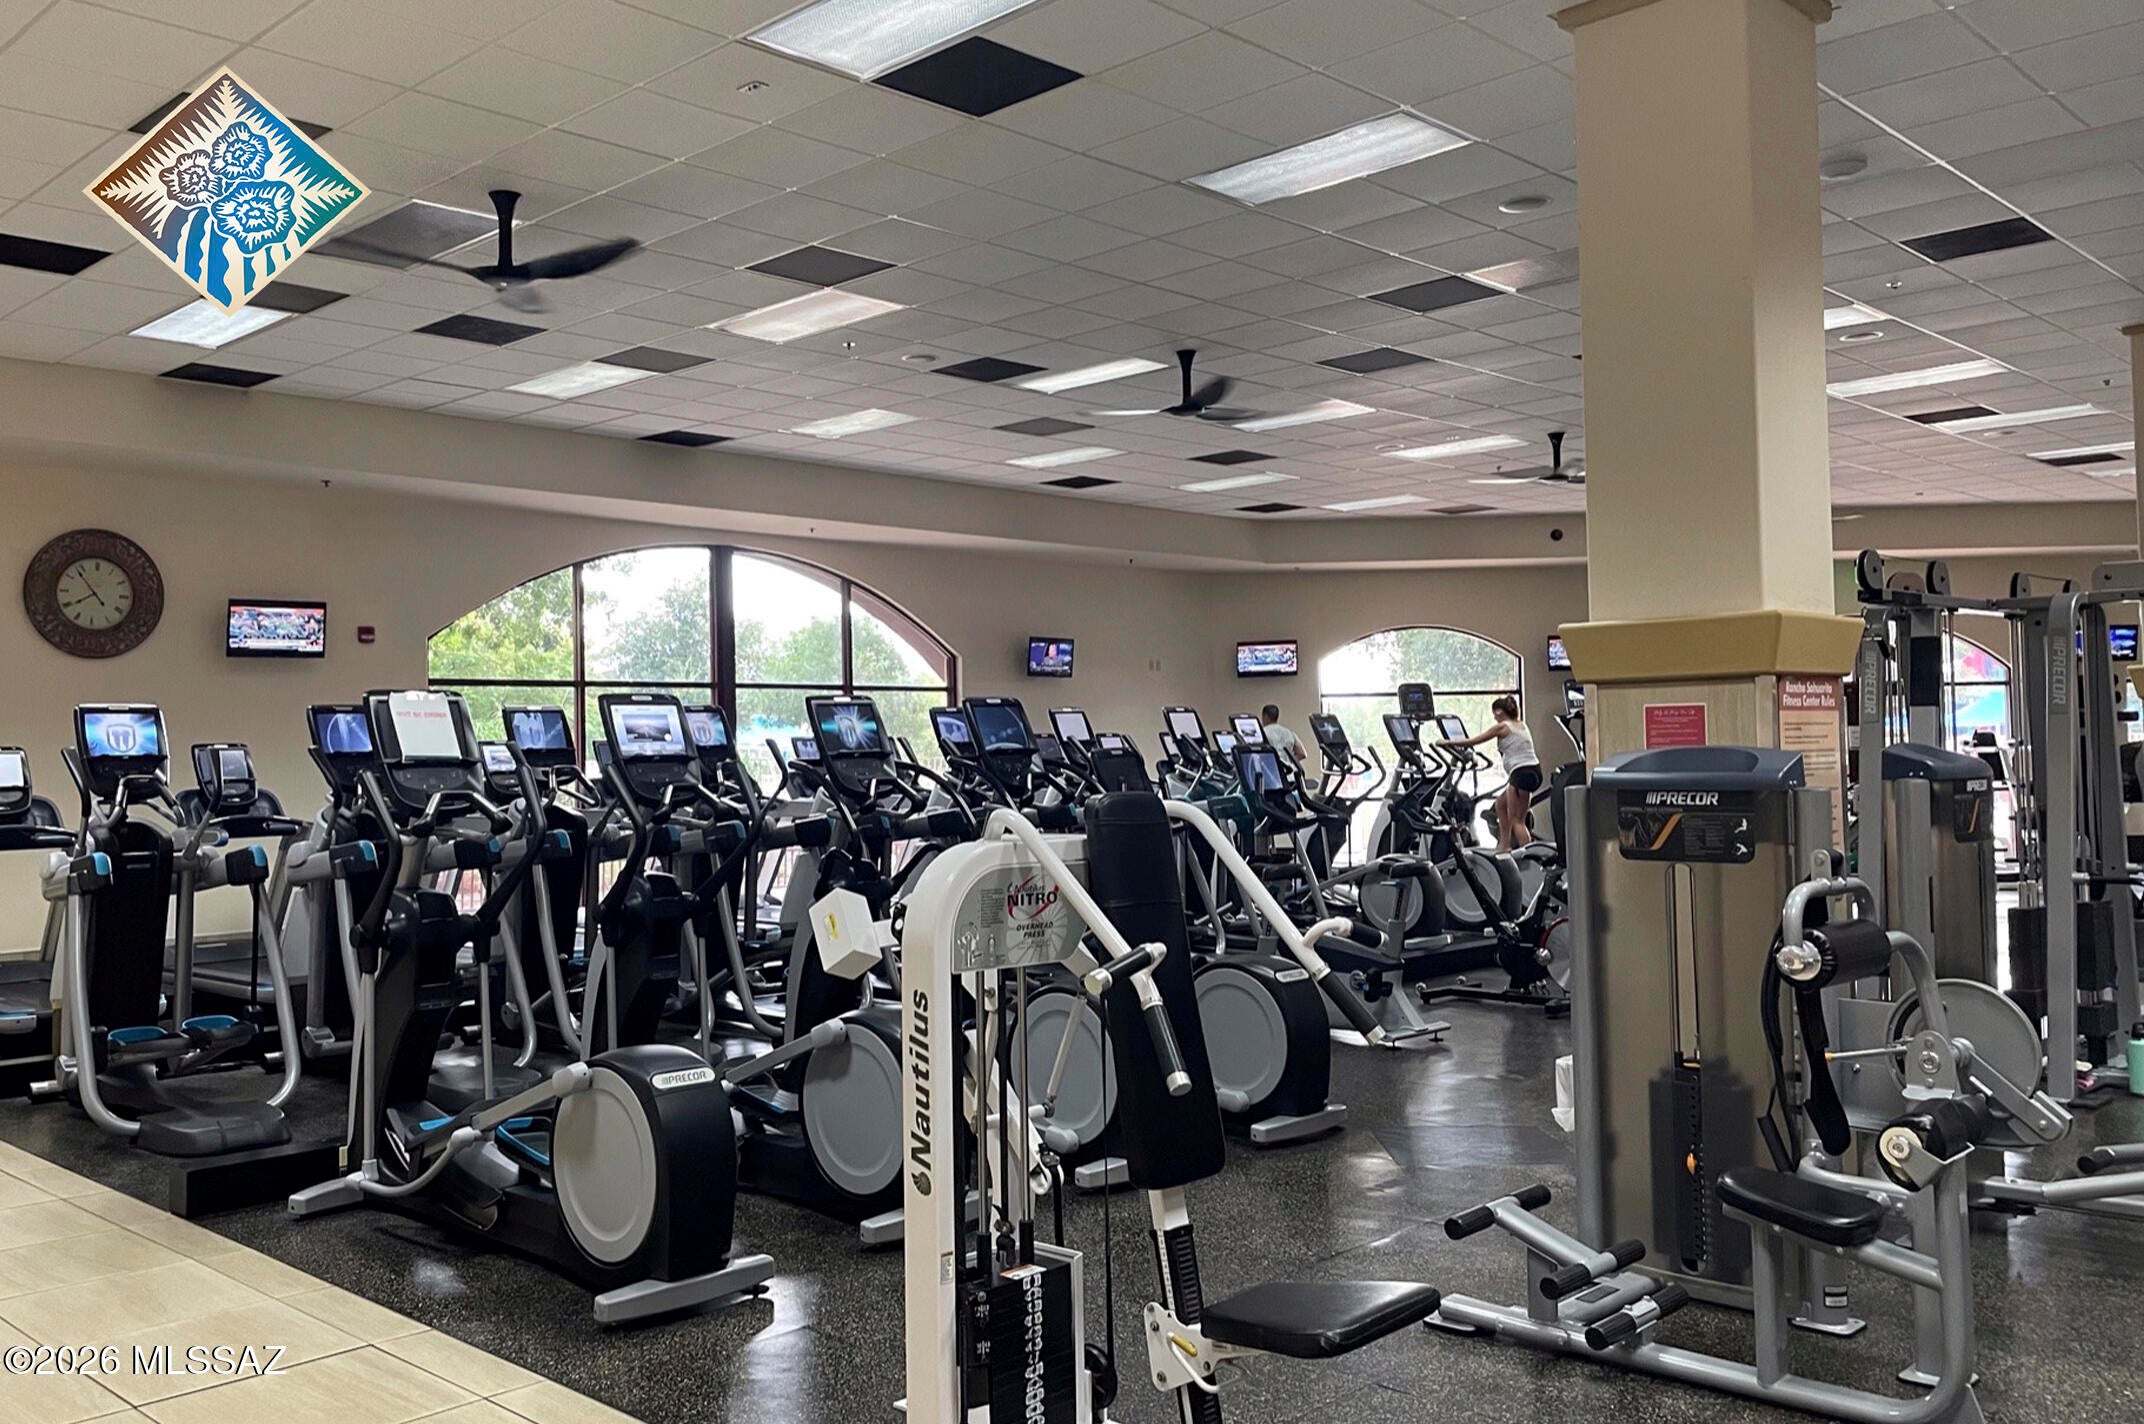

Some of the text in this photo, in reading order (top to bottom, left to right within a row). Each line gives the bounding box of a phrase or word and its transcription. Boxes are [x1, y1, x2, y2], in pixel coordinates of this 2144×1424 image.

[2053, 645, 2066, 705] PRECOR
[1785, 681, 1805, 693] Rancho
[1864, 658, 1877, 714] PRECOR
[1783, 694, 1836, 707] Fitness Center Rules
[1656, 791, 1719, 806] PRECOR
[1007, 890, 1058, 907] NITRO
[1016, 921, 1054, 932] OVERHEAD
[1023, 930, 1046, 939] PRESS
[668, 1070, 708, 1085] PRECOR
[908, 988, 931, 1171] Nautilus
